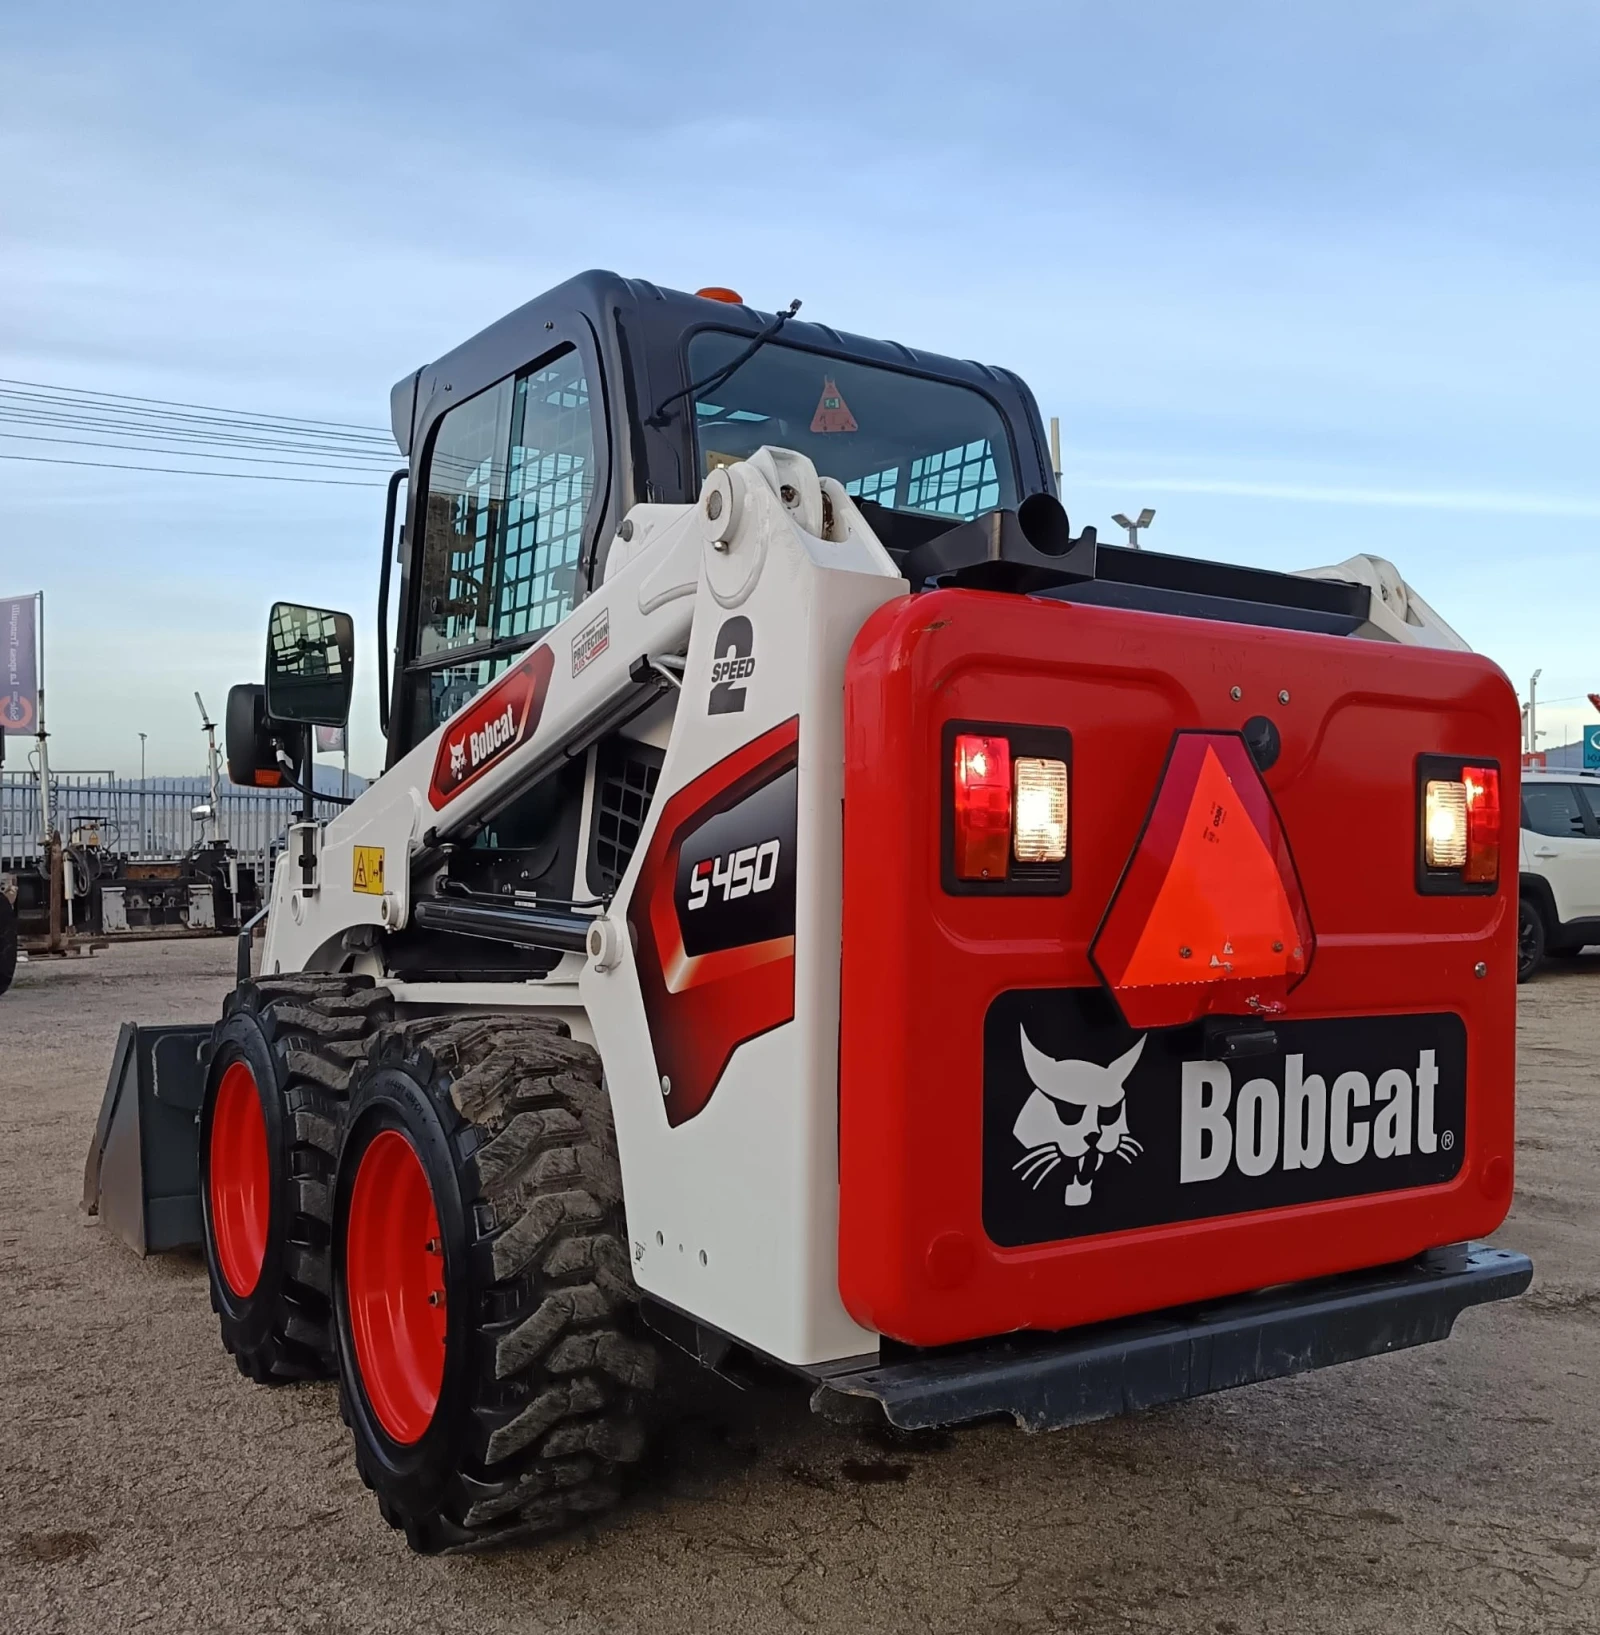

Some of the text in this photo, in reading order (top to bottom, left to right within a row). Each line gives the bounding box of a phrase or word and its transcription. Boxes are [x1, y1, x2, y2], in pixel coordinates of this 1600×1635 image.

[574, 622, 608, 664] PROTECTION
[711, 657, 756, 683] SPEED
[469, 703, 515, 767] Bobcat
[688, 839, 780, 911] S450
[1180, 1049, 1439, 1184] Bobcat
